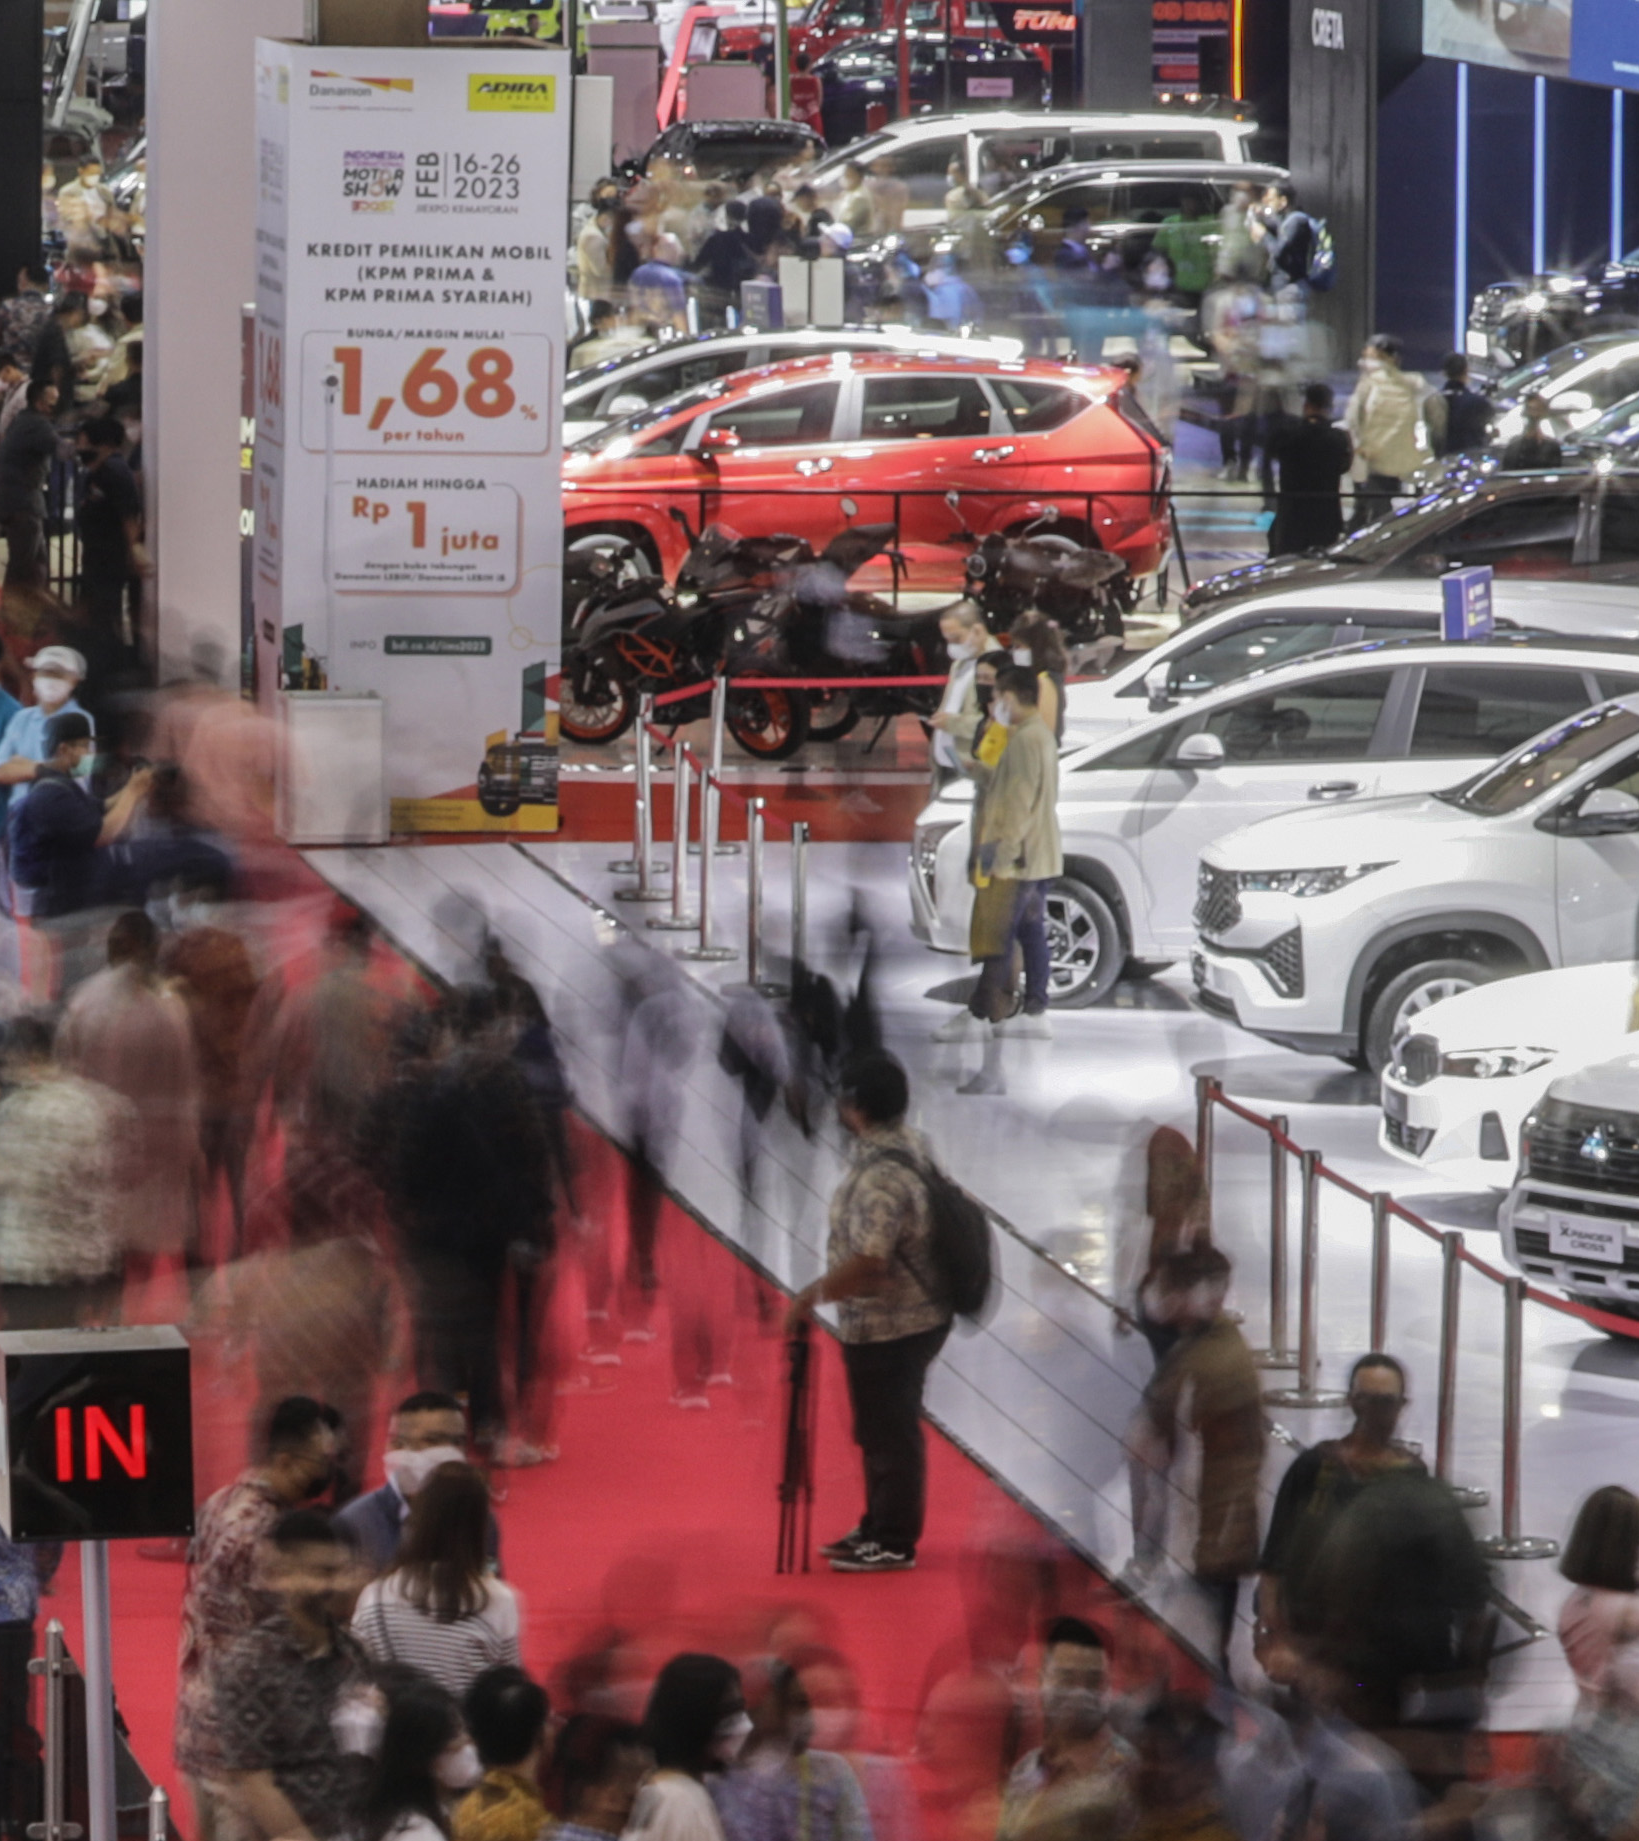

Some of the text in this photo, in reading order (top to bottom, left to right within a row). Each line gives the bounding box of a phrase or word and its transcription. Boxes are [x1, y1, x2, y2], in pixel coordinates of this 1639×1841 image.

[1312, 9, 1344, 51] CRETA
[309, 84, 372, 97] Danamon
[477, 82, 549, 94] ADIRA
[453, 152, 521, 175] 16-26
[342, 168, 405, 181] MOTOR
[415, 151, 440, 198] FEB
[453, 176, 520, 199] 2023
[451, 203, 519, 215] KEMAYORAN
[307, 243, 553, 260] KREDIT PEMILIKAN MOBIL
[357, 266, 496, 282] (KPM PRIMA &
[324, 288, 533, 306] KPM PRIMA SYARIAH)
[346, 328, 505, 340] BUNGA/MARGIN MULAI
[333, 346, 517, 431] 1,68
[519, 404, 539, 421] %
[383, 428, 466, 444] per tahun
[356, 478, 487, 491] HADIAH HINGGA
[352, 495, 500, 557] Rp 1 juta
[350, 640, 377, 650] INFO
[1559, 1226, 1614, 1243] XPANDER
[1570, 1239, 1606, 1253] CROSS
[55, 1403, 146, 1482] IN
